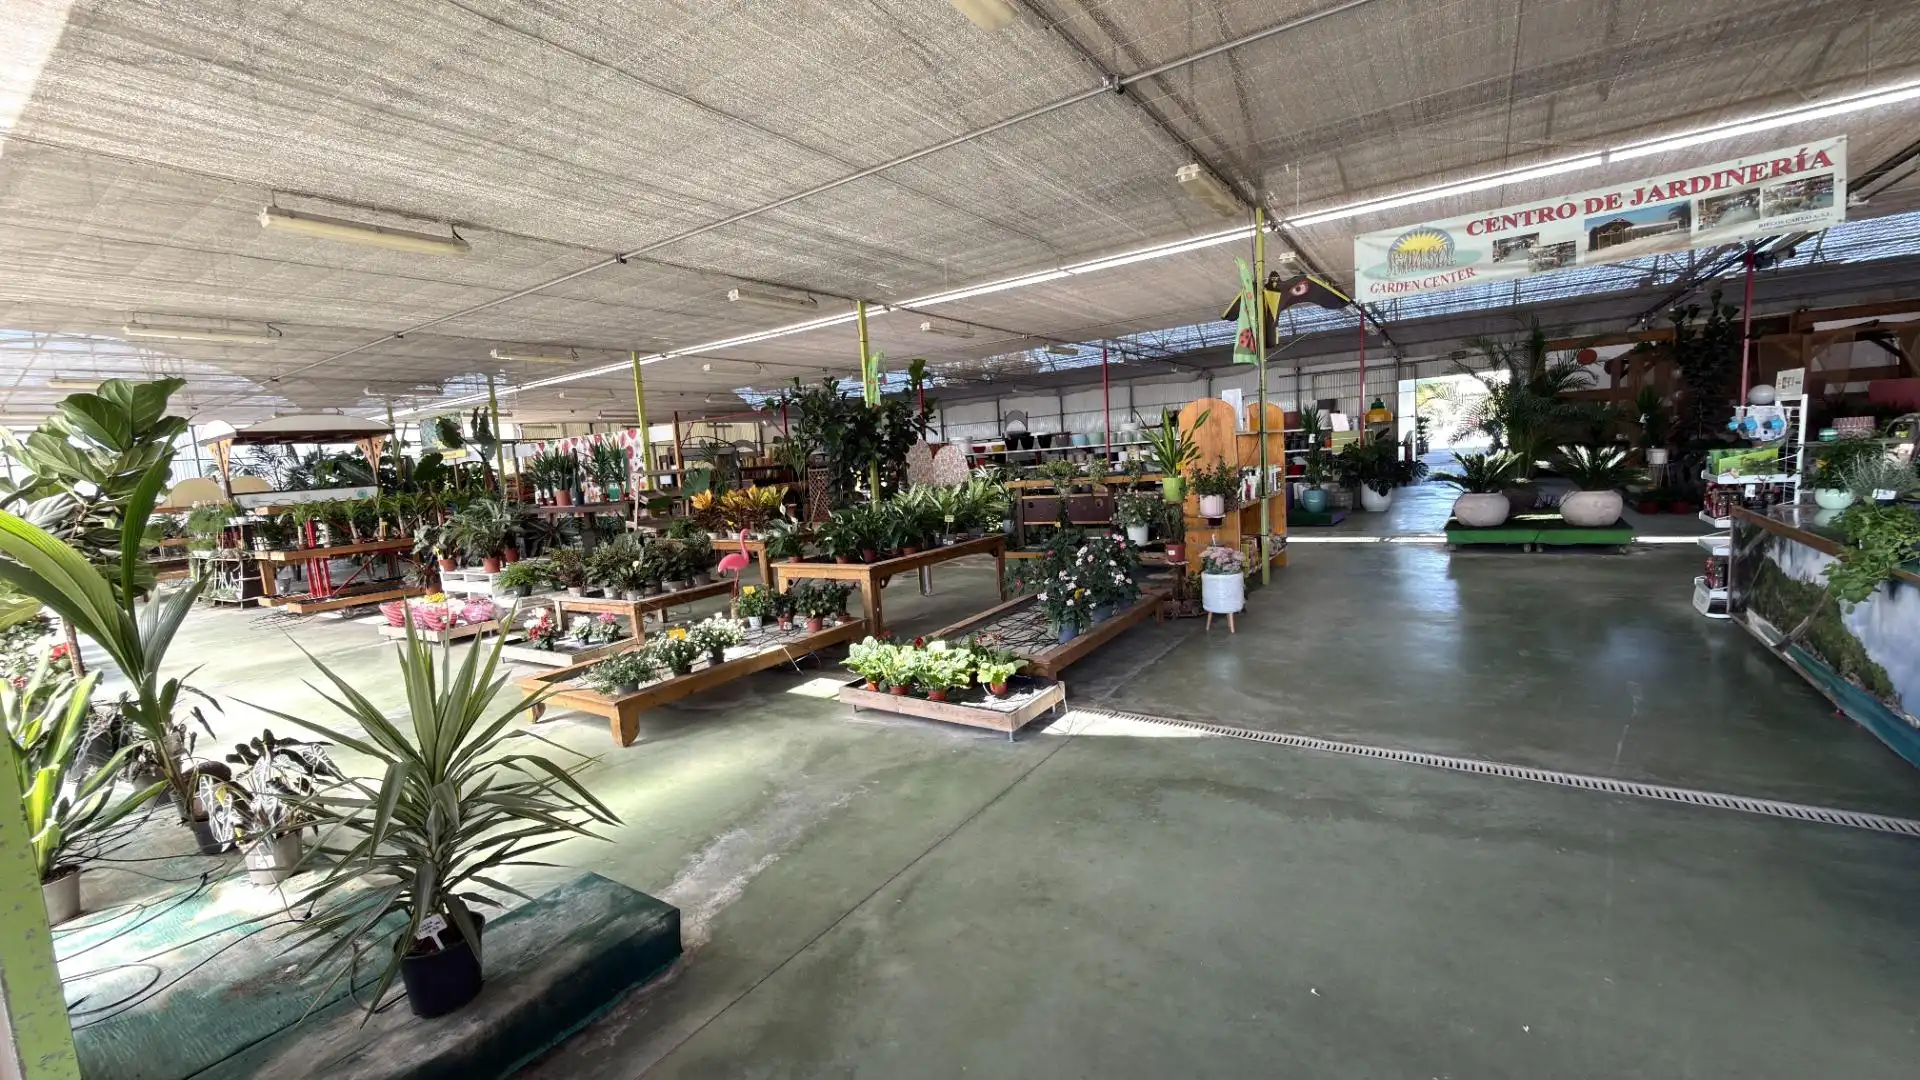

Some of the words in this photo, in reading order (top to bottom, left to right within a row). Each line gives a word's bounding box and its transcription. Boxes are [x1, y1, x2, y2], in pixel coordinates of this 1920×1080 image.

[1466, 202, 1577, 236] CENTRO
[1583, 192, 1623, 215] DE
[1629, 147, 1834, 206] JARDINERÍA
[1370, 279, 1420, 294] GARDEN
[1423, 267, 1476, 289] CENTER
